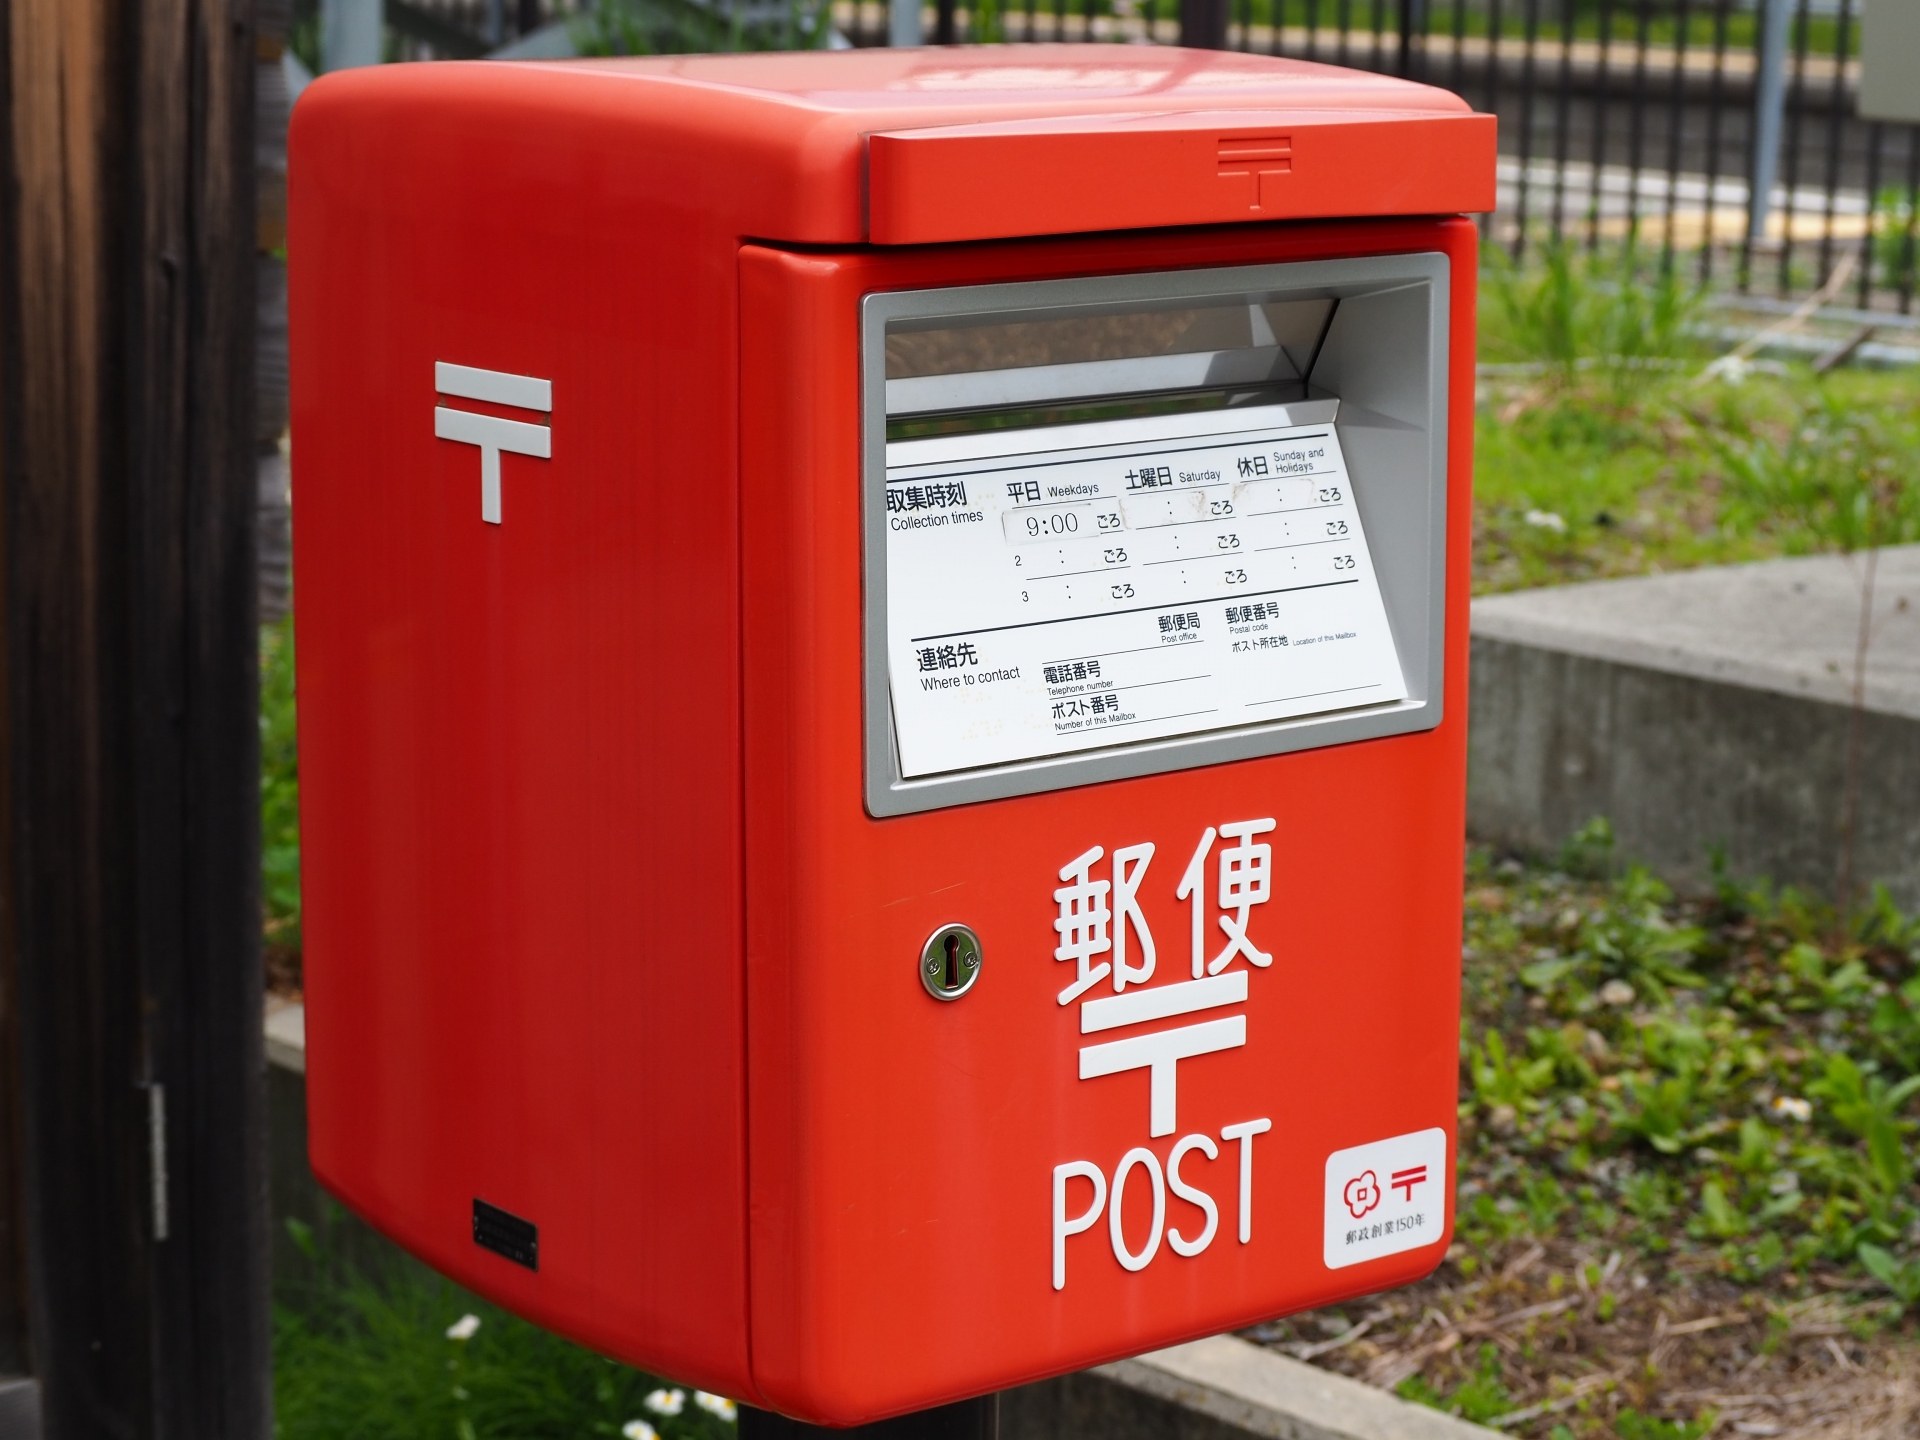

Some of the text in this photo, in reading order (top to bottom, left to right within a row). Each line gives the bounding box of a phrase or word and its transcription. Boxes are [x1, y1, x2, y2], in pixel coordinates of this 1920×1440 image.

[1273, 447, 1324, 461] Sunday and
[1237, 456, 1268, 478] 休日
[1276, 462, 1313, 473] Holidays
[1124, 466, 1173, 490] 土曜日
[1179, 469, 1221, 483] Saturday
[886, 481, 968, 513] 取集時刻
[1006, 480, 1041, 503] 平日
[1047, 483, 1099, 498] Weekdays
[1319, 487, 1341, 502] ごろ
[1210, 500, 1233, 515] ごろ
[891, 511, 984, 531] Collection times
[1026, 512, 1078, 537] 9:00
[1097, 513, 1121, 529] ごろ
[1326, 521, 1349, 536] ごろ
[1217, 534, 1240, 549] ごろ
[1014, 555, 1022, 567] 2
[1104, 548, 1128, 563] ごろ
[1333, 555, 1356, 570] ごろ
[1224, 569, 1248, 584] ごろ
[1021, 591, 1029, 602] 3
[1111, 583, 1135, 599] ごろ
[1225, 602, 1279, 625] 郵便番号
[1158, 611, 1201, 633] 郵便局
[1229, 623, 1268, 635] Postal code
[1161, 632, 1197, 643] Post office
[1231, 634, 1289, 653] ポスト所在地
[1292, 631, 1356, 646] Location of this Mailbox
[916, 642, 978, 672] 連絡先
[920, 666, 1020, 691] Where to contact
[1043, 660, 1101, 684] 電話番号
[1047, 680, 1114, 696] Telephone number
[1051, 694, 1119, 719] ポスト番号
[1054, 712, 1137, 731] Number of this Mailbox
[1053, 817, 1276, 1006] 郵便
[1052, 1118, 1272, 1290] POST
[1345, 1213, 1425, 1245] 郵政創業150年
